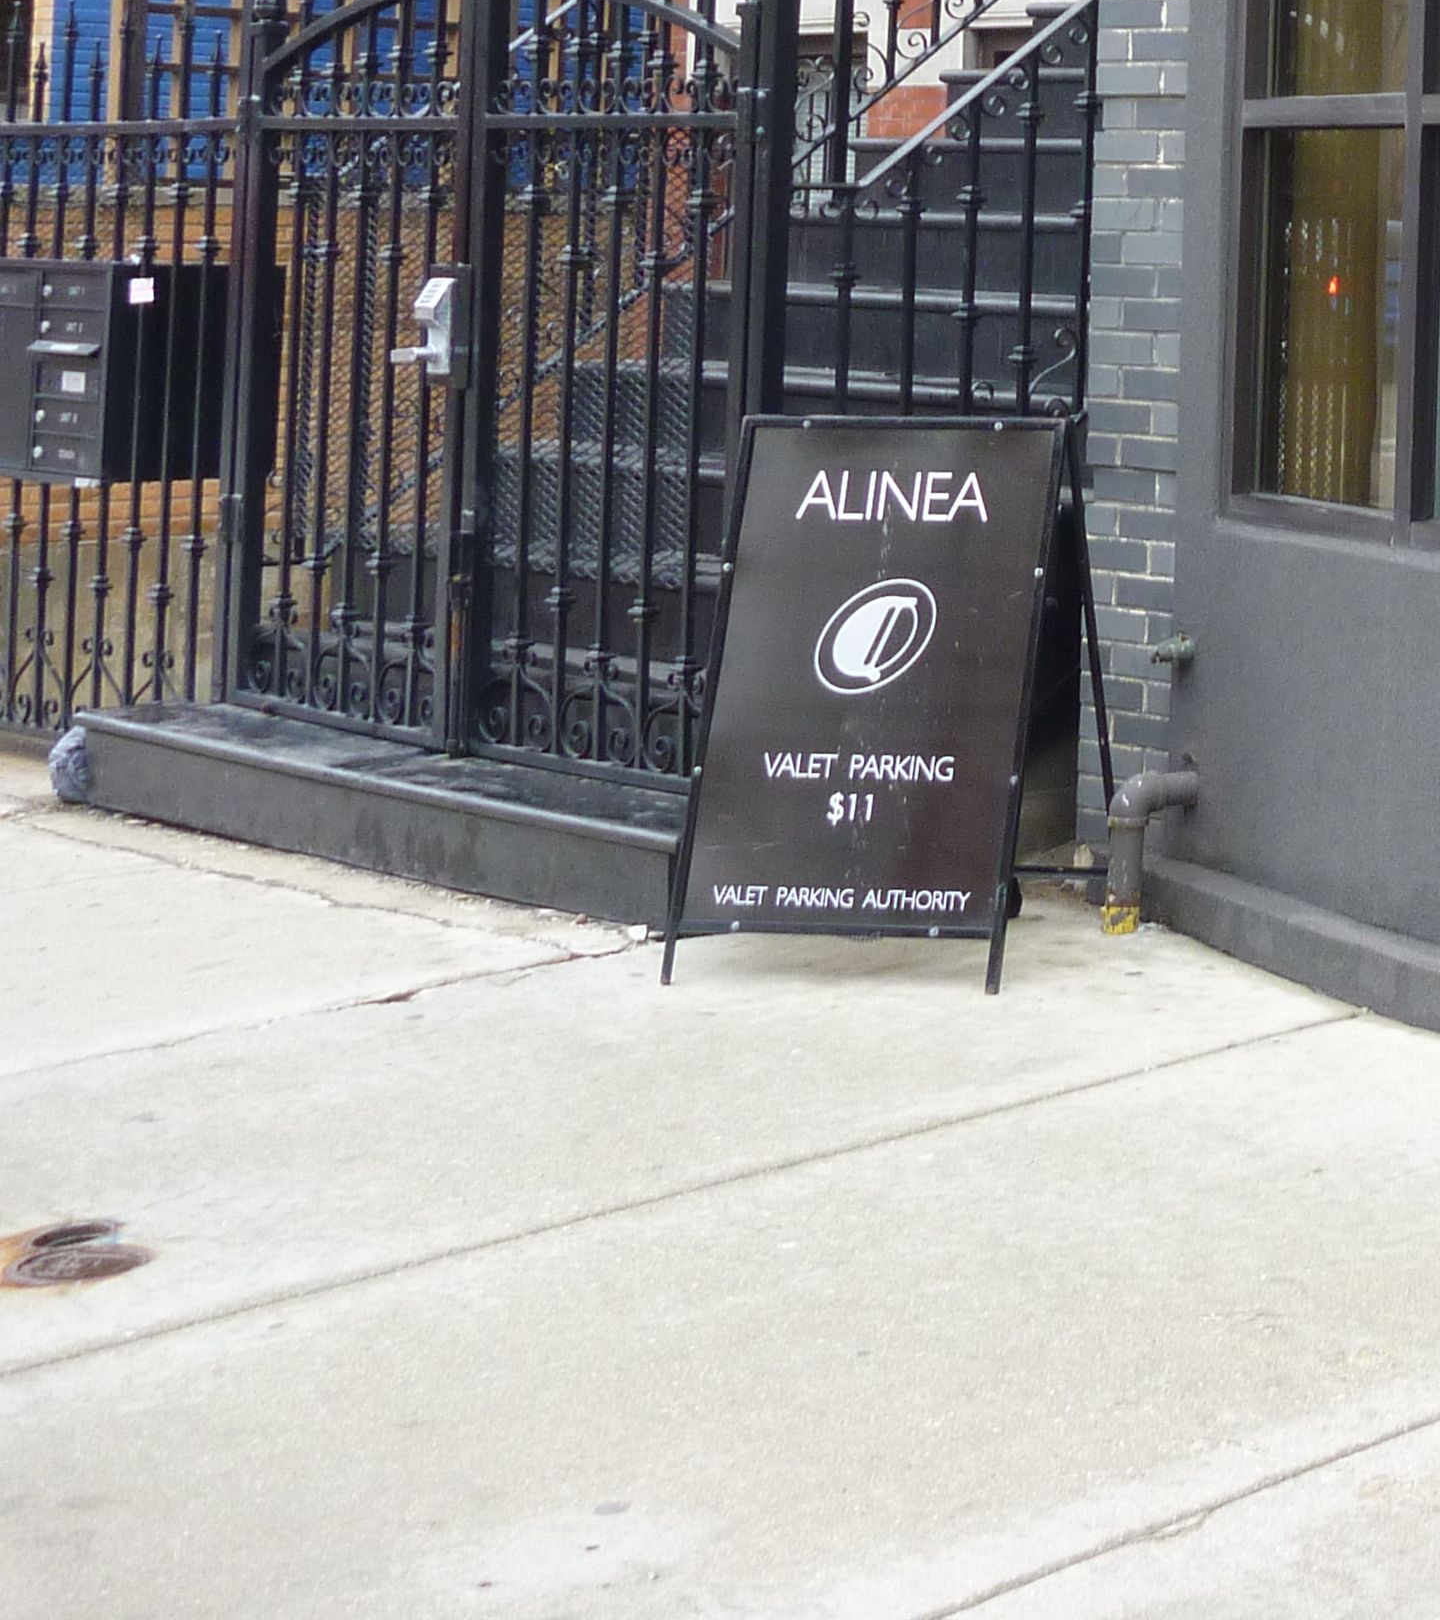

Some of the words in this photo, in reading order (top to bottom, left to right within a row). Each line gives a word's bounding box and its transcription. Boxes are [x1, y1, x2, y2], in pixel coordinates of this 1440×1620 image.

[796, 470, 988, 523] ALINEA
[764, 751, 840, 779] VALET
[849, 754, 955, 781] PARKING
[827, 792, 874, 825] $11
[713, 884, 768, 906] VALET
[776, 886, 855, 909] PARKING
[862, 888, 971, 912] AUTHORITY
